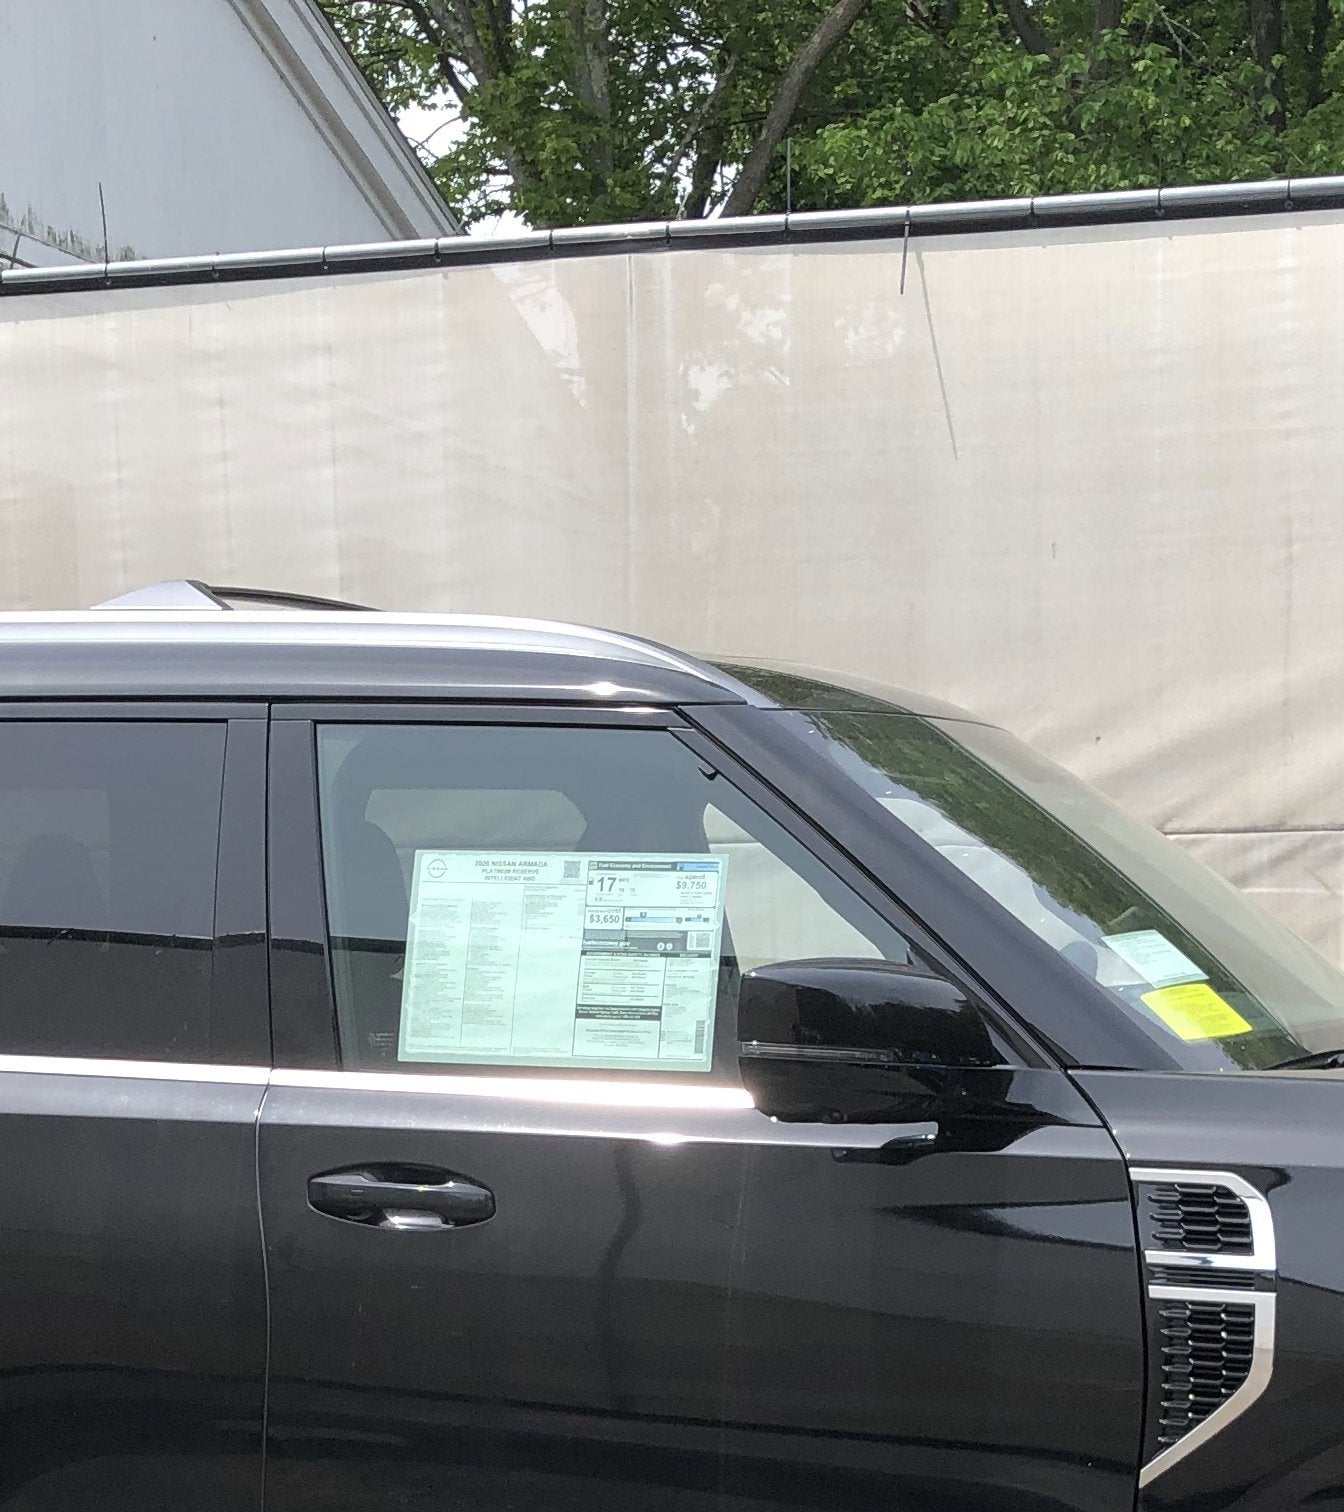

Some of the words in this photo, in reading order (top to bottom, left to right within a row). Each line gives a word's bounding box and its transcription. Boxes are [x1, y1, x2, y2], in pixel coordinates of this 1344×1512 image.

[597, 876, 617, 892] 17
[676, 880, 707, 890] $9,750
[589, 914, 620, 924] $3,650
